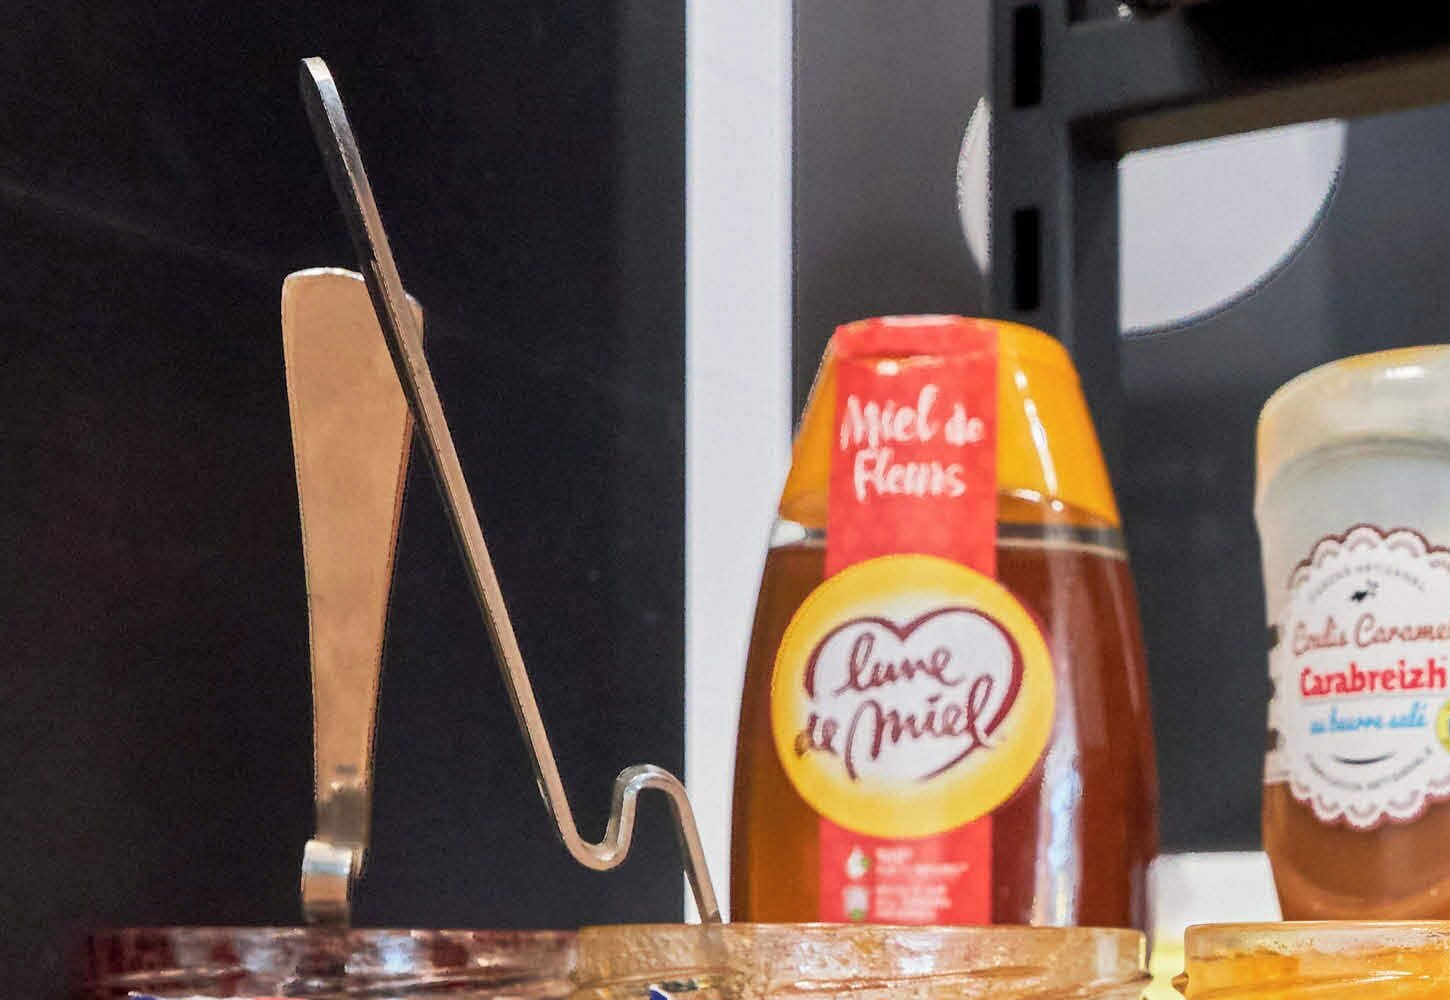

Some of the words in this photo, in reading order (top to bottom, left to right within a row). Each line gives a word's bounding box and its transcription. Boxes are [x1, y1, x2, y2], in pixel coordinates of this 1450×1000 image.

[840, 384, 939, 450] Miel
[944, 402, 984, 446] de
[854, 448, 966, 502] Fleurs
[833, 631, 965, 696] lune
[1300, 657, 1448, 697] Carabreizh
